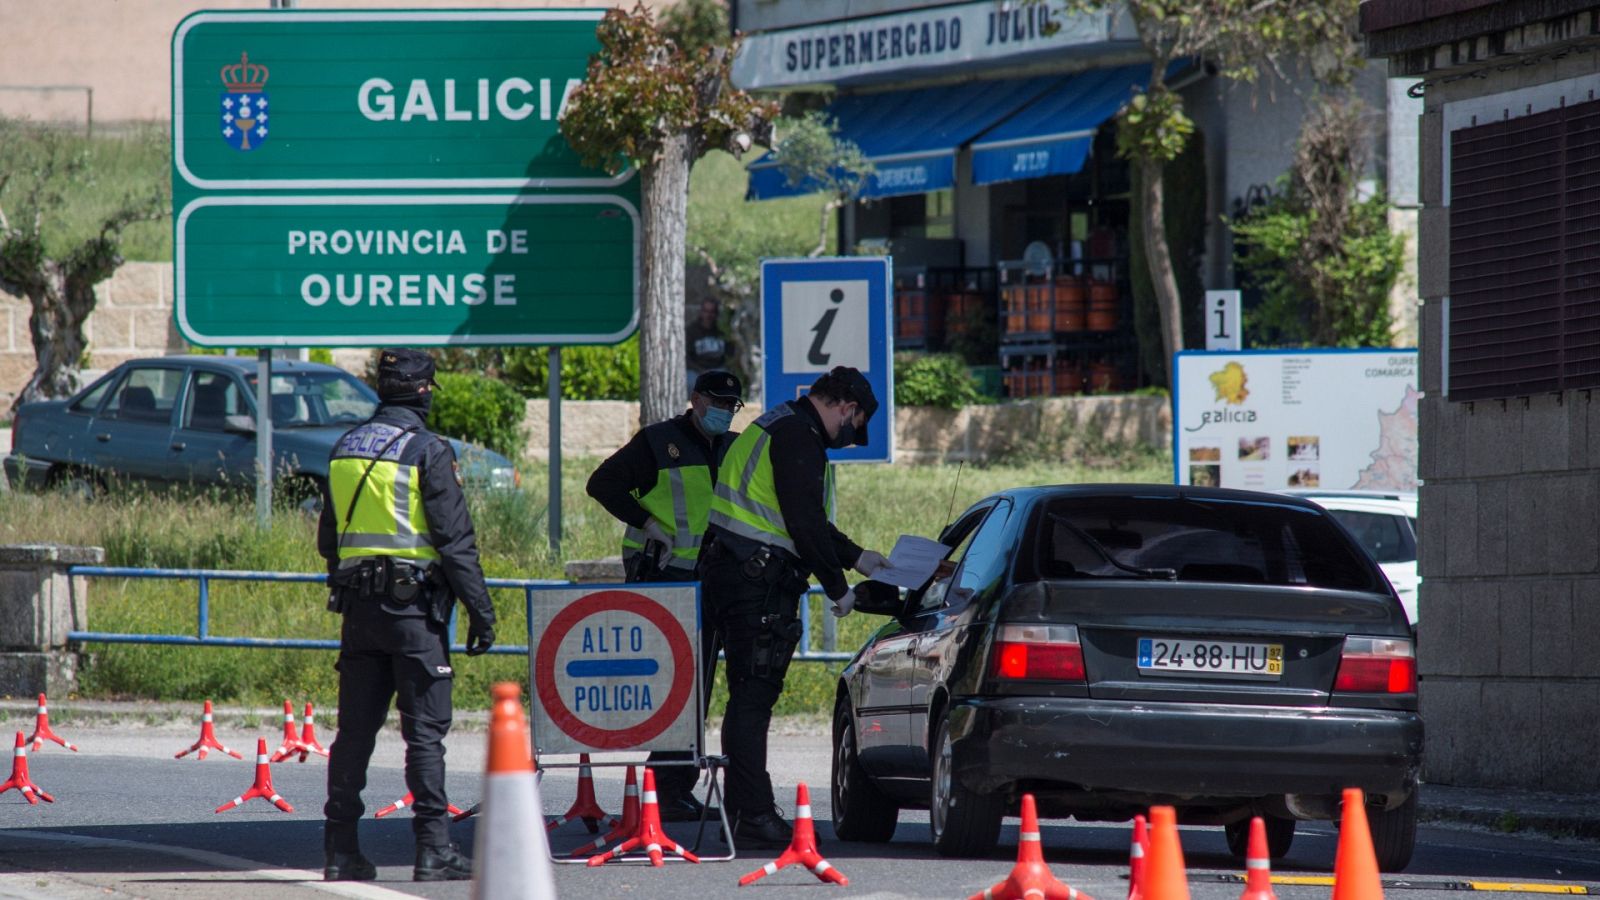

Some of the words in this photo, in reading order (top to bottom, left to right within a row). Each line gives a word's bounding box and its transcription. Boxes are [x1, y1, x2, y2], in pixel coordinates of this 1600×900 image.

[786, 16, 962, 72] SUPERMERCADO
[986, 4, 1052, 45] JULIO
[288, 230, 466, 254] PROVINCIA
[486, 230, 528, 254] DE
[301, 273, 518, 307] OURENSE
[1365, 368, 1415, 378] COMARCA
[1184, 408, 1257, 432] galicia
[582, 626, 642, 653] ALTO
[1269, 663, 1280, 671] 01
[575, 685, 652, 712] POLICIA
